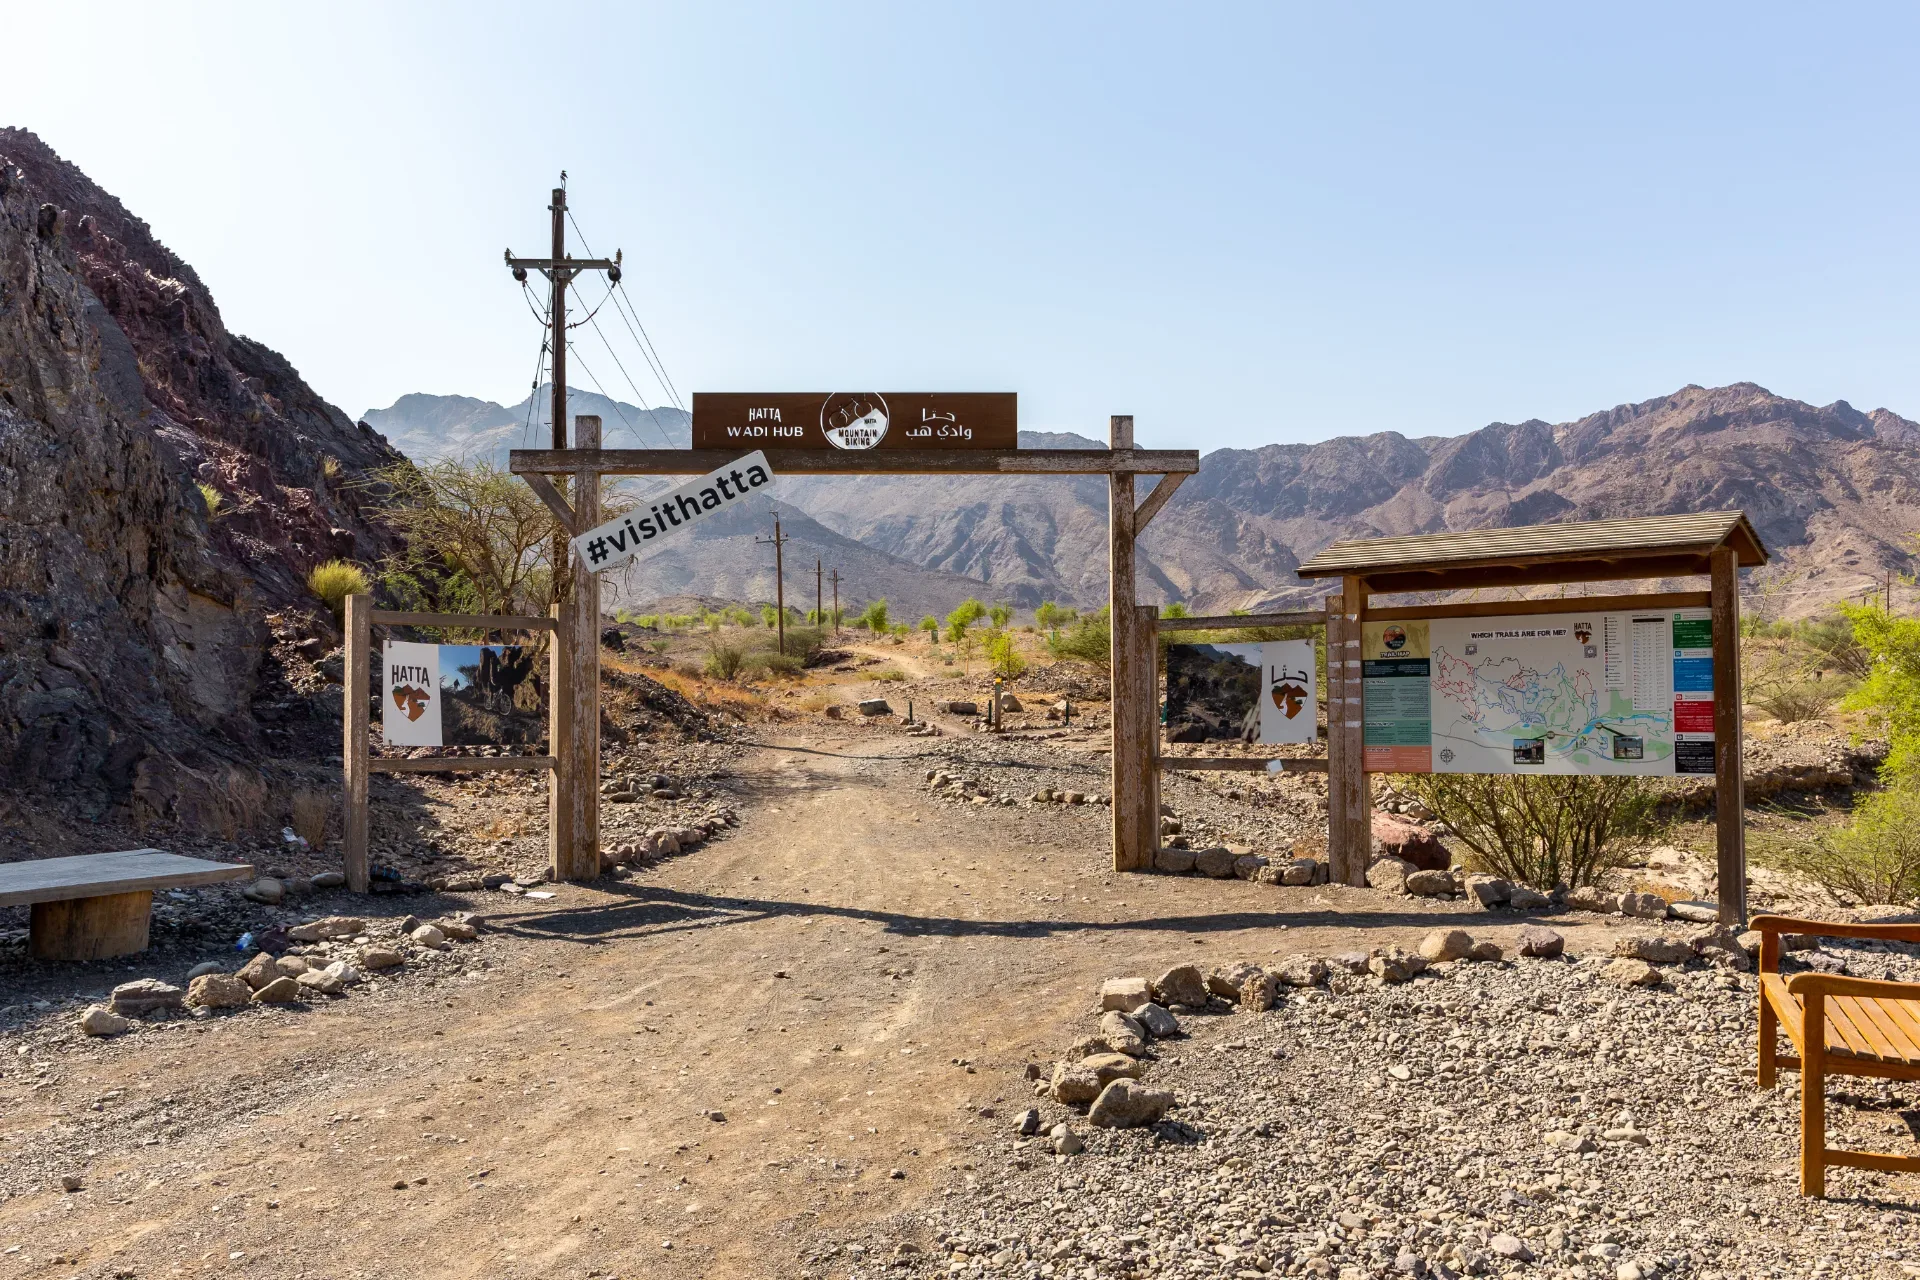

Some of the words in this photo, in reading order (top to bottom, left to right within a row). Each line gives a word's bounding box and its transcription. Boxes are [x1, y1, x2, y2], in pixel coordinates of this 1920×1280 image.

[749, 407, 781, 422] HATTA
[727, 426, 768, 437] WADI
[773, 426, 804, 437] HUB
[838, 429, 877, 438] MOUNTAIN
[937, 425, 972, 440] وادي
[845, 438, 870, 446] BIKING
[587, 465, 769, 564] #visithatta
[1573, 622, 1592, 631] HATTA
[391, 664, 431, 688] HATTA
